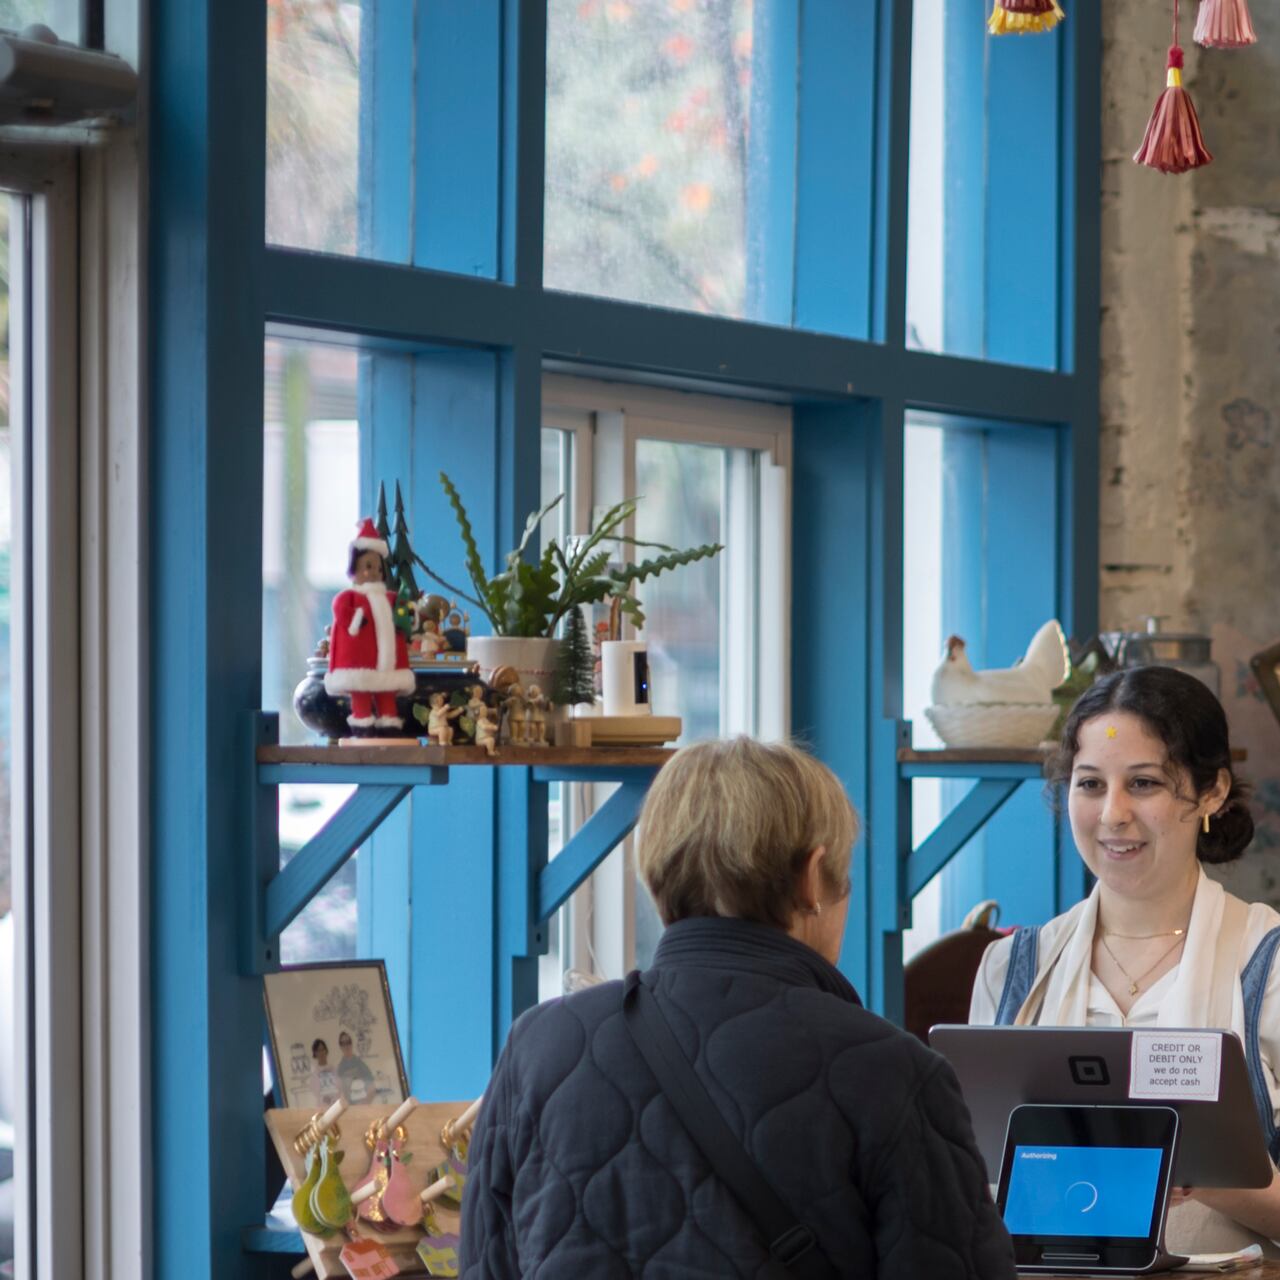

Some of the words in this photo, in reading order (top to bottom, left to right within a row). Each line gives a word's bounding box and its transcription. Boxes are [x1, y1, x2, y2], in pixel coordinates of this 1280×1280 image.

[1151, 1043, 1185, 1052] CREDIT
[1187, 1044, 1201, 1052] OR
[1149, 1054, 1177, 1063] DEBIT
[1178, 1055, 1204, 1063] ONLY
[1169, 1066, 1180, 1074] do
[1182, 1067, 1197, 1075] not
[1149, 1078, 1178, 1087] accept
[1180, 1078, 1201, 1086] cash
[1021, 1152, 1057, 1161] Authorizing
